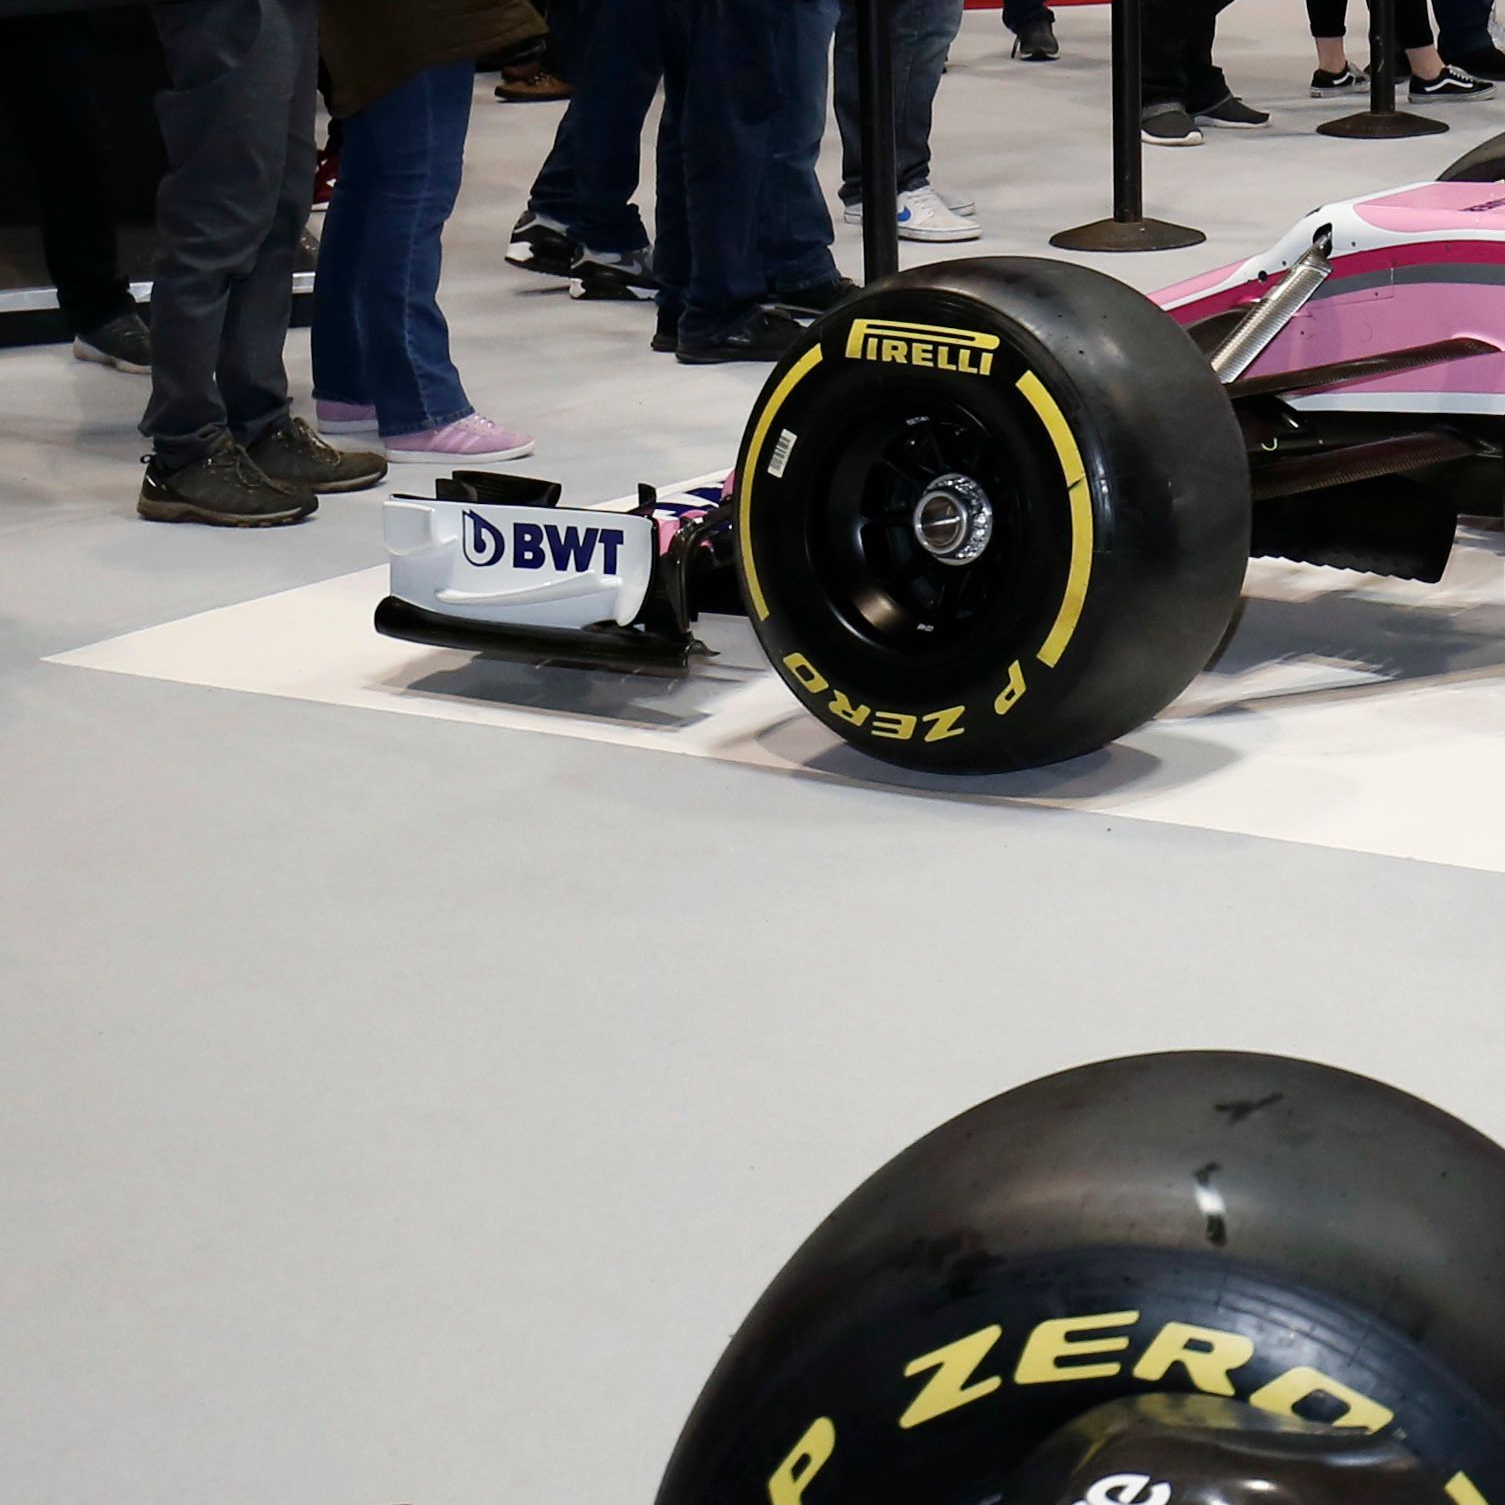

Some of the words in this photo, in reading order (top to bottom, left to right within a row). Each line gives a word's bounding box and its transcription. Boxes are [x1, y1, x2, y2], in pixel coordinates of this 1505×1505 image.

[845, 318, 1001, 377] PIRELLI
[511, 523, 625, 575] BWT
[783, 651, 966, 745] ZERO
[993, 659, 1029, 717] P
[897, 1309, 1405, 1437] ZERO
